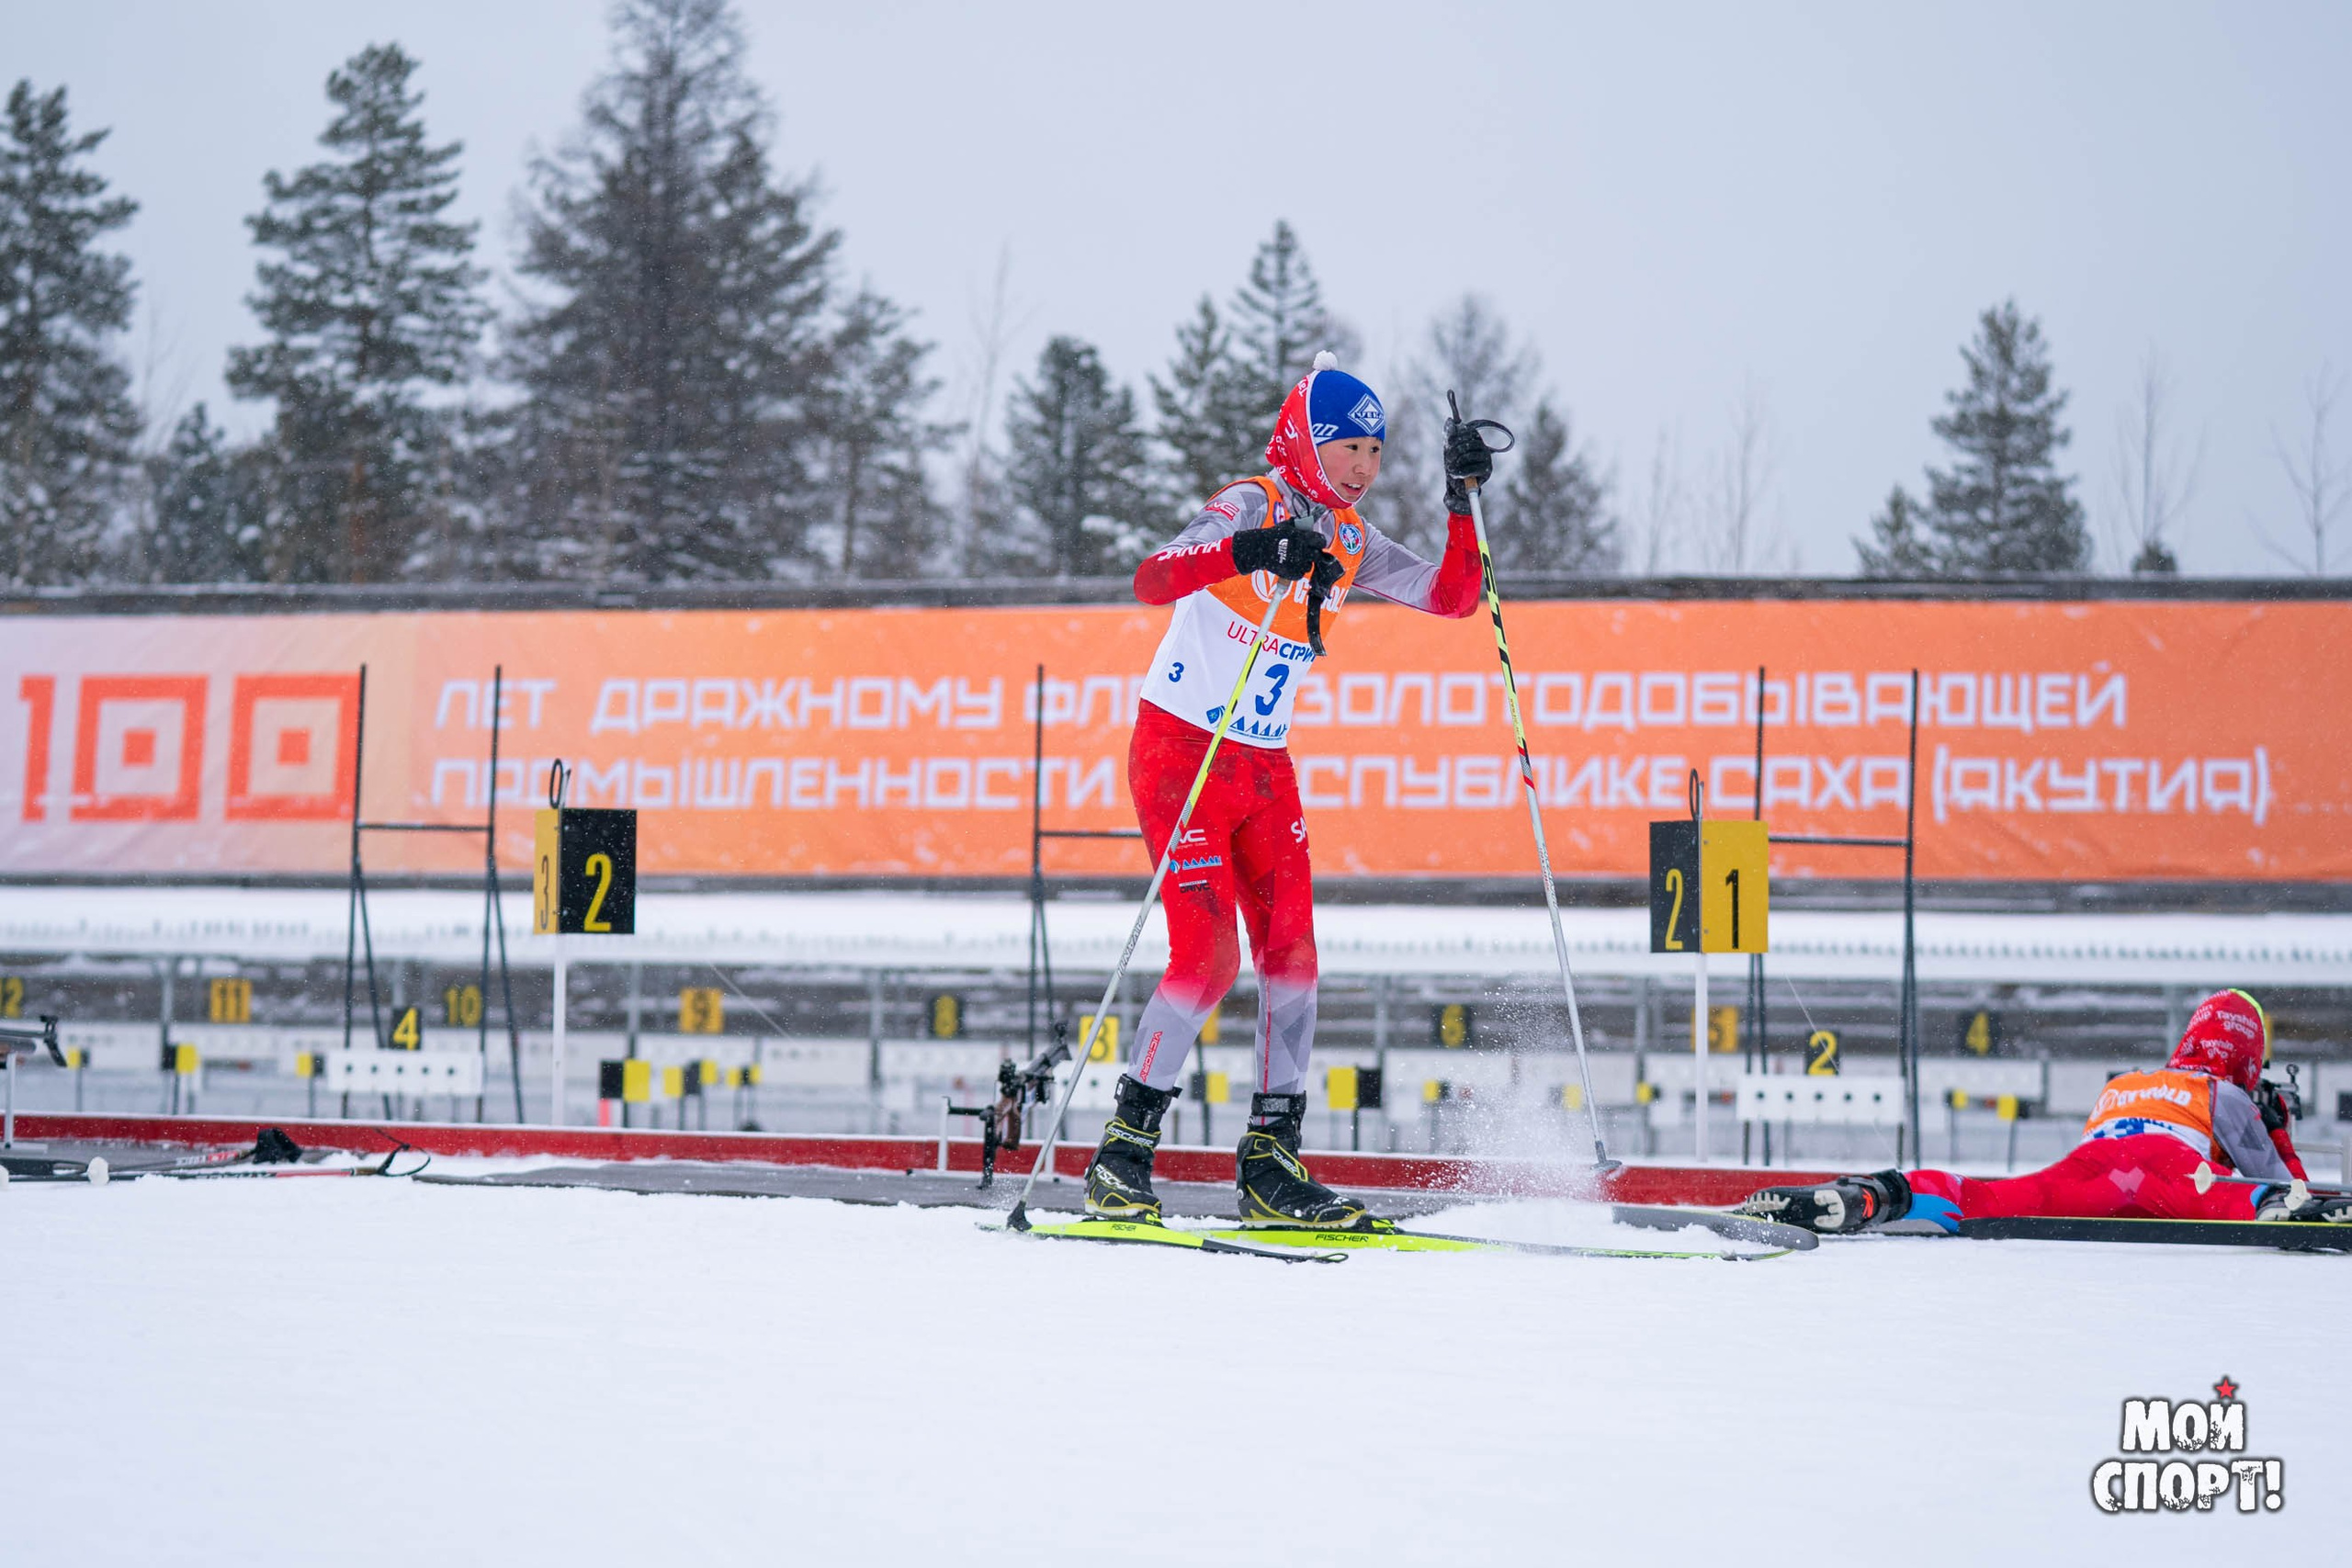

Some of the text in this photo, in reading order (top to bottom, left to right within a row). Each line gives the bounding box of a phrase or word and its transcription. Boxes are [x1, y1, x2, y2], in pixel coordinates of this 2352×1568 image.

[1168, 661, 1184, 682] 3
[1255, 663, 1290, 716] 3
[435, 679, 557, 730] ЛЕТ
[590, 677, 1002, 734] ДРАЖНОМУ
[19, 675, 362, 821] 100
[431, 744, 2270, 825] ПРОМЫШЛЕННОСТИ СПУБЛИКЕ САХА (ЯКУТИЯ)
[540, 854, 549, 931] 3
[583, 853, 612, 932] 2
[1665, 868, 1683, 951] 2
[1725, 869, 1739, 950] 1
[0, 976, 23, 1019] 2
[447, 985, 481, 1027] 10
[393, 1007, 420, 1052] 4
[1807, 1030, 1838, 1077] 2
[1966, 1011, 1992, 1055] 4
[1139, 1031, 1164, 1084] VICTORY
[1315, 1233, 1369, 1244] FISCHER
